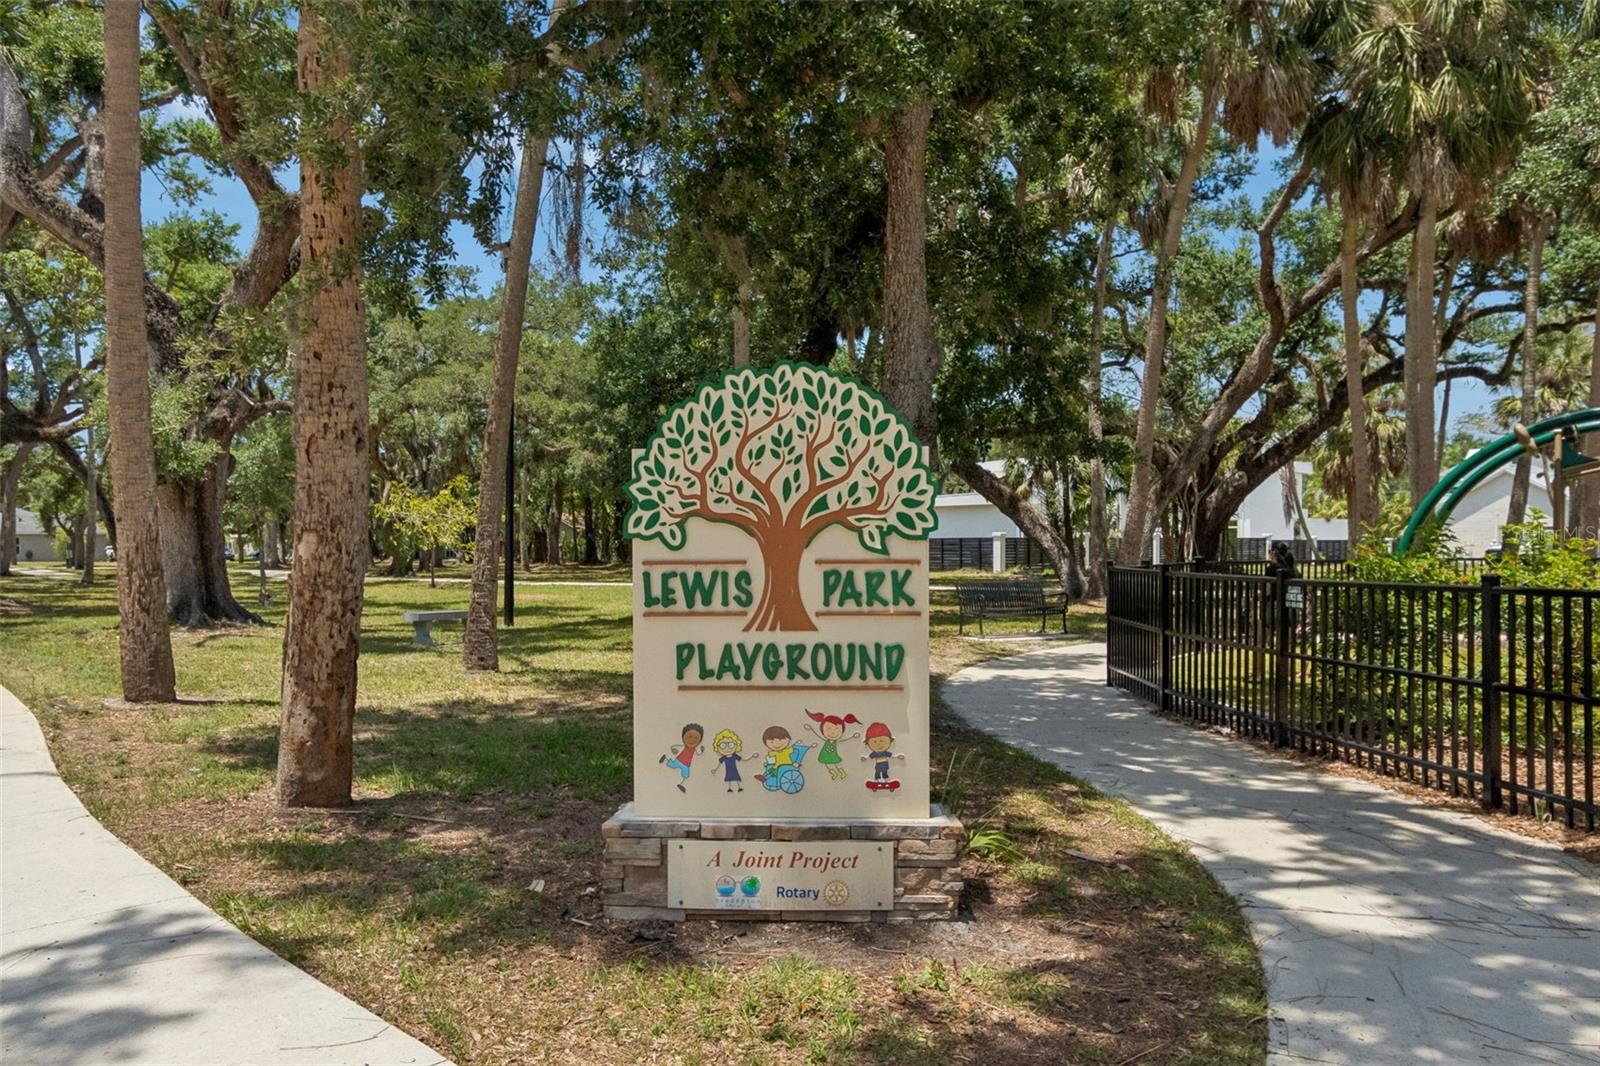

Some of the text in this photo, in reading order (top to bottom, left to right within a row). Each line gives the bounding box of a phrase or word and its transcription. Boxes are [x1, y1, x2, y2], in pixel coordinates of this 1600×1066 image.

[642, 569, 915, 609] LEWIS PARK
[676, 642, 906, 682] PLAYGROUND
[706, 850, 859, 873] A Joint Project
[776, 886, 820, 901] Rotary
